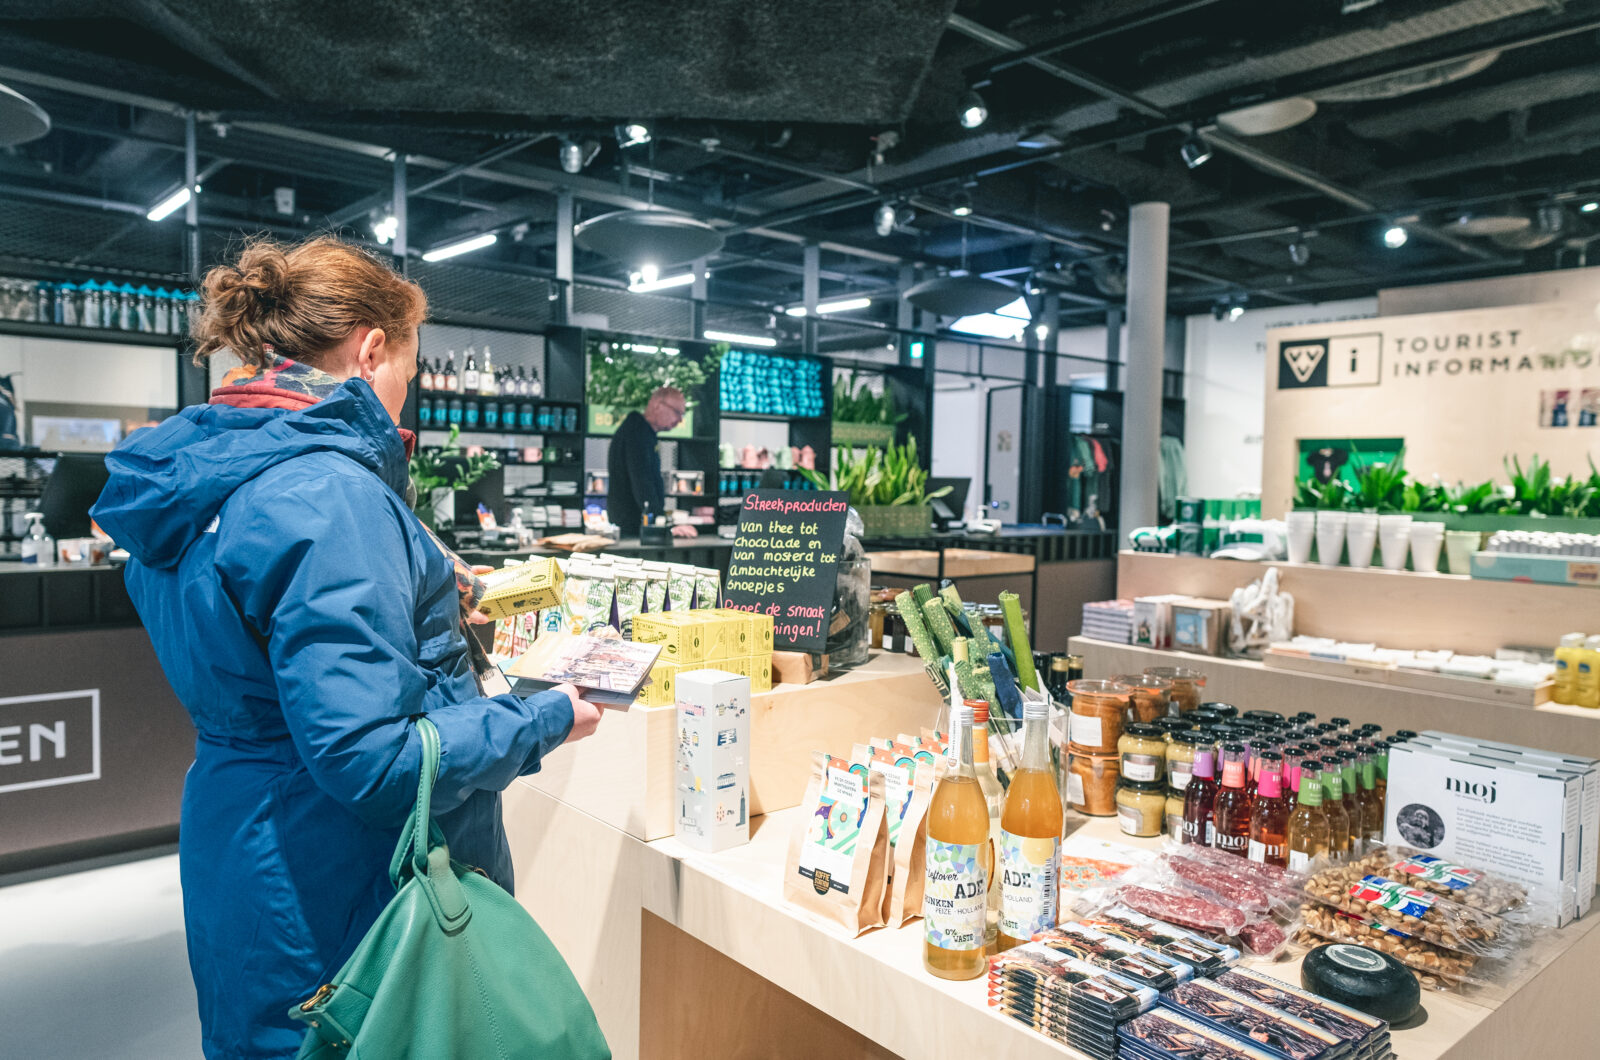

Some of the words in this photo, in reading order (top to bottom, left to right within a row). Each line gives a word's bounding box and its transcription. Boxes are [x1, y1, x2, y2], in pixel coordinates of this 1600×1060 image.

[1394, 330, 1521, 353] TOURIST
[740, 521, 763, 533] van
[768, 520, 794, 534] thee
[800, 521, 819, 535] tot
[734, 536, 801, 549] chocolade
[808, 540, 822, 550] en
[733, 551, 755, 561] van
[763, 551, 815, 563] mosterd
[820, 552, 837, 564] tot
[765, 602, 782, 617] de
[786, 604, 826, 620] smaak
[1445, 776, 1497, 804] moj
[953, 933, 974, 943] WASTE
